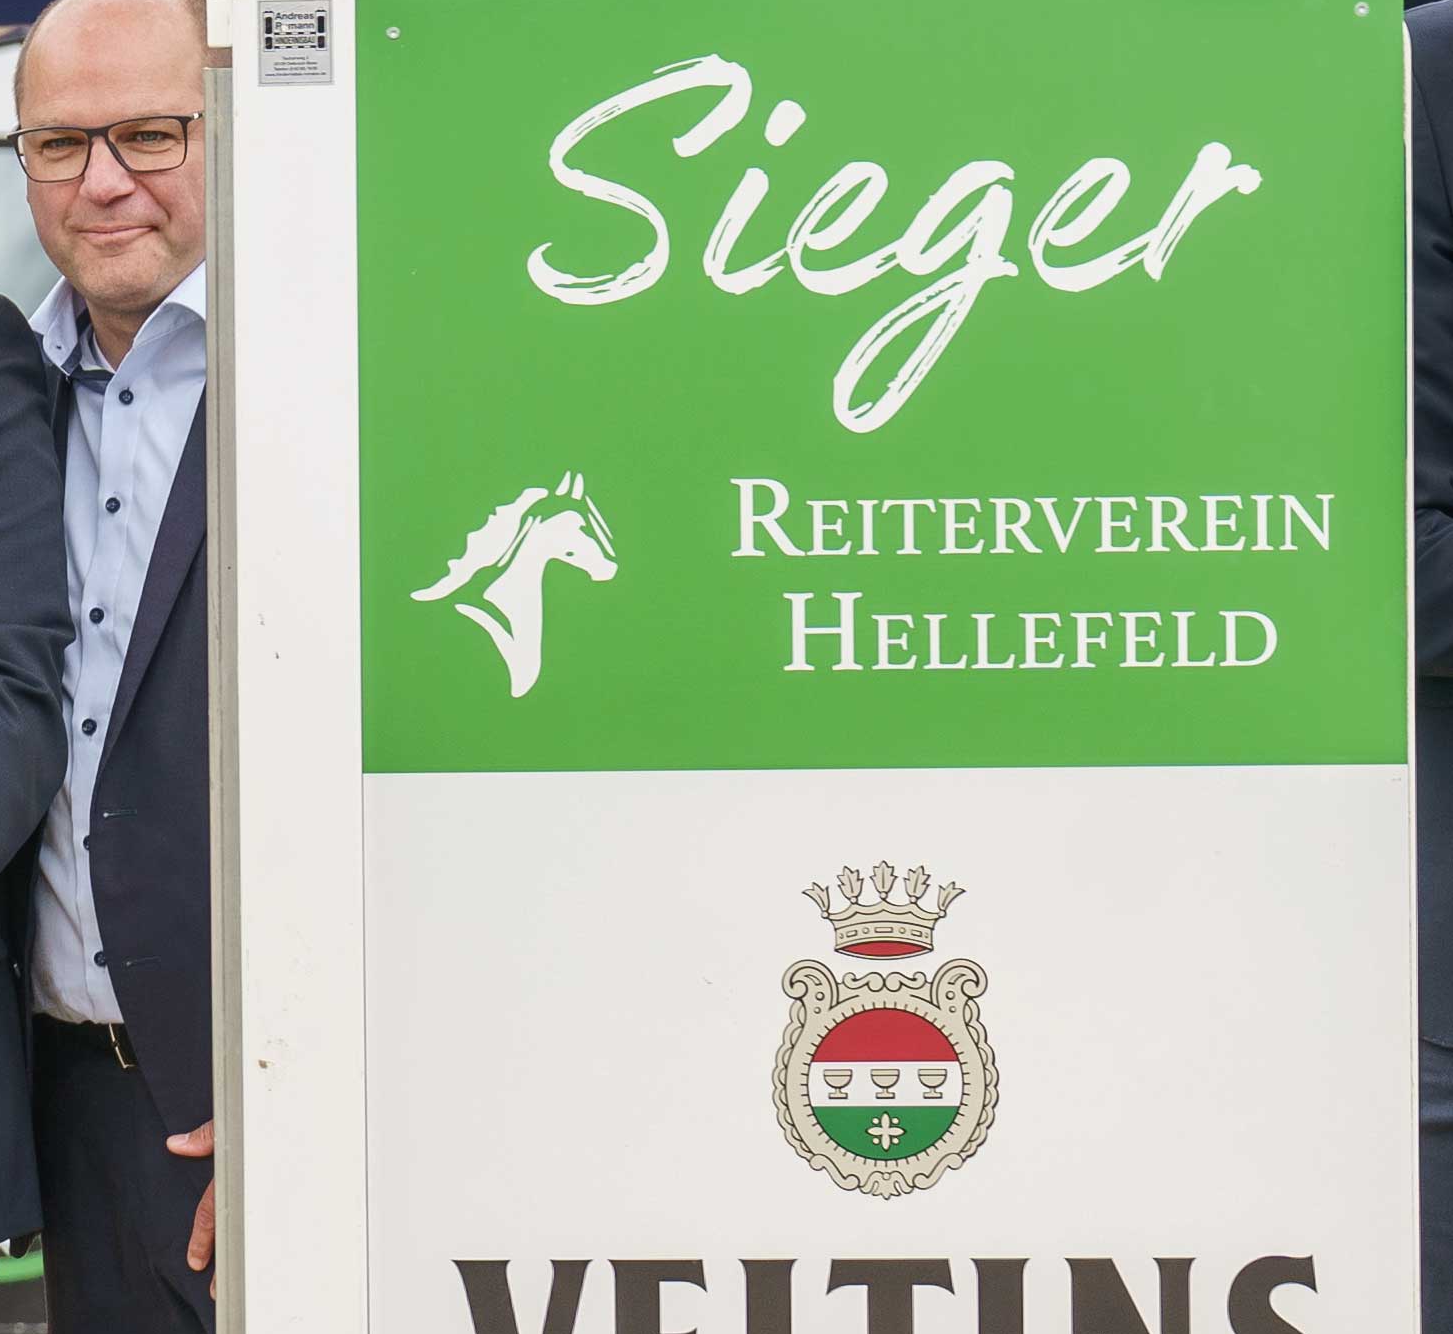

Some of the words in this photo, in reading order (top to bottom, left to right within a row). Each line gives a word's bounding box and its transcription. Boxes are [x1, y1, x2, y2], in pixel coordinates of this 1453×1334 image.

[274, 12, 315, 20] Andreas
[527, 54, 1262, 433] Sieger
[731, 479, 1334, 556] REITERVEREIN
[784, 592, 1277, 670] HELLEFELD
